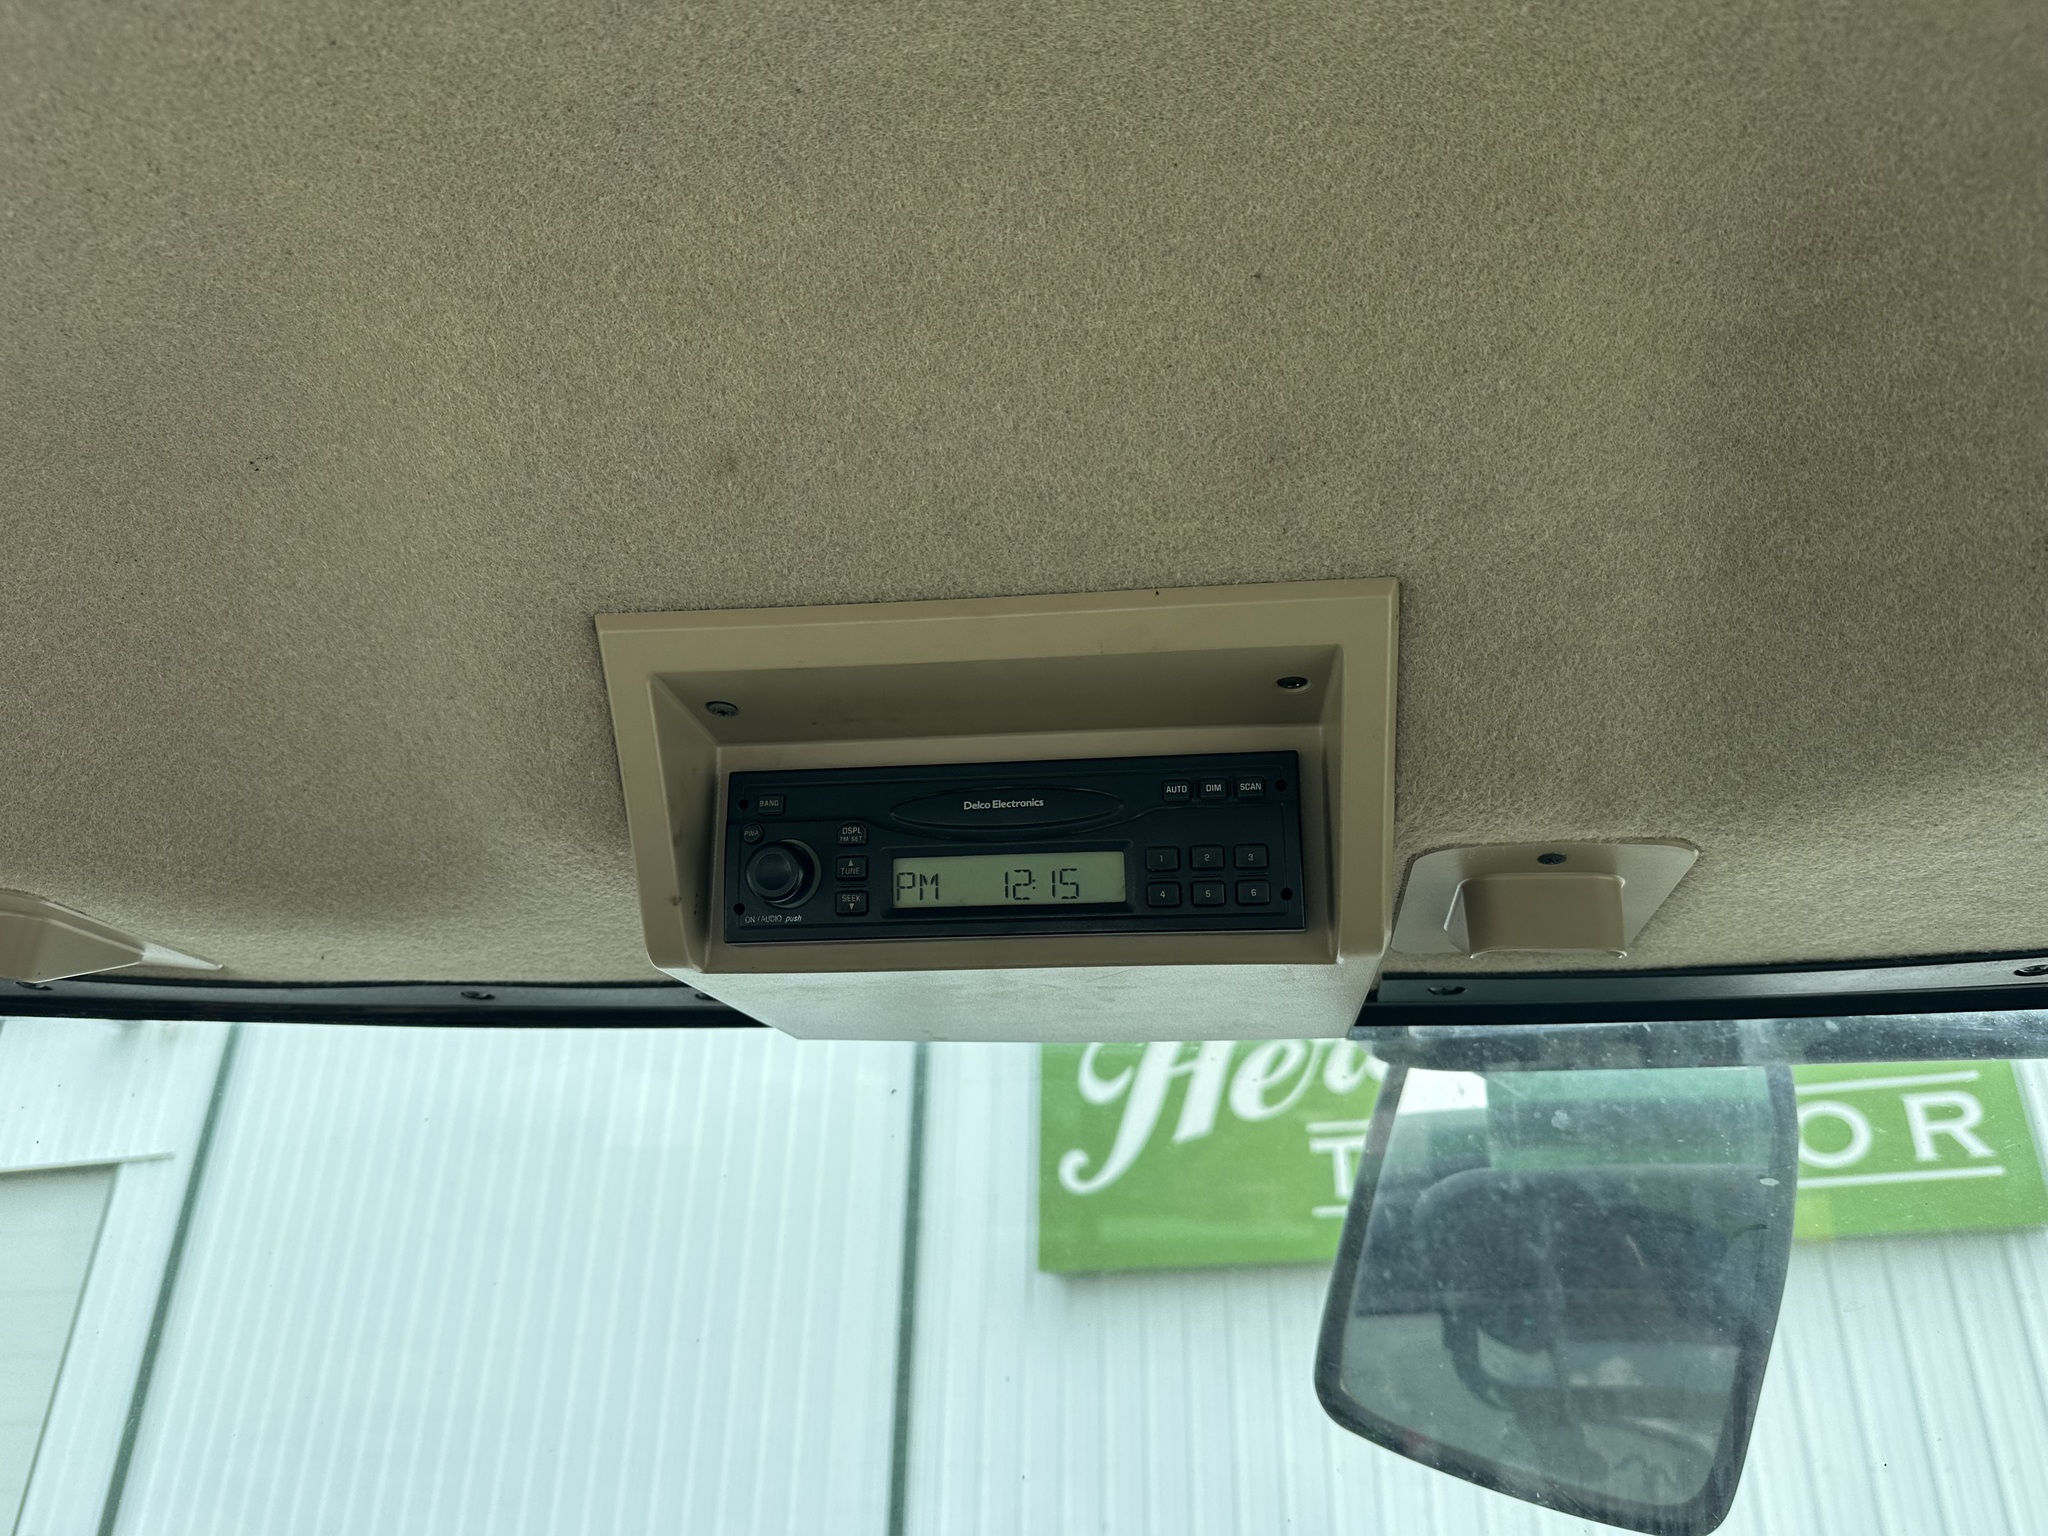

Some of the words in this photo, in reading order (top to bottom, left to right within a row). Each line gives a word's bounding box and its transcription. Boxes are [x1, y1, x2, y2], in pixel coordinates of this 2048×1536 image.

[1166, 785, 1188, 793] AUTO
[1205, 784, 1222, 792] DIM
[1239, 782, 1262, 791] SCAN
[963, 800, 991, 810] Delco
[992, 798, 1044, 809] Electronics
[842, 827, 862, 835] DSPL
[1248, 853, 1254, 861] 3
[840, 867, 861, 875] TUNE
[896, 872, 939, 901] PM
[1004, 868, 1080, 900] 12:15
[1159, 890, 1165, 898] 4
[1251, 888, 1257, 896] 6
[841, 894, 861, 902] SEEK
[784, 914, 803, 924] push
